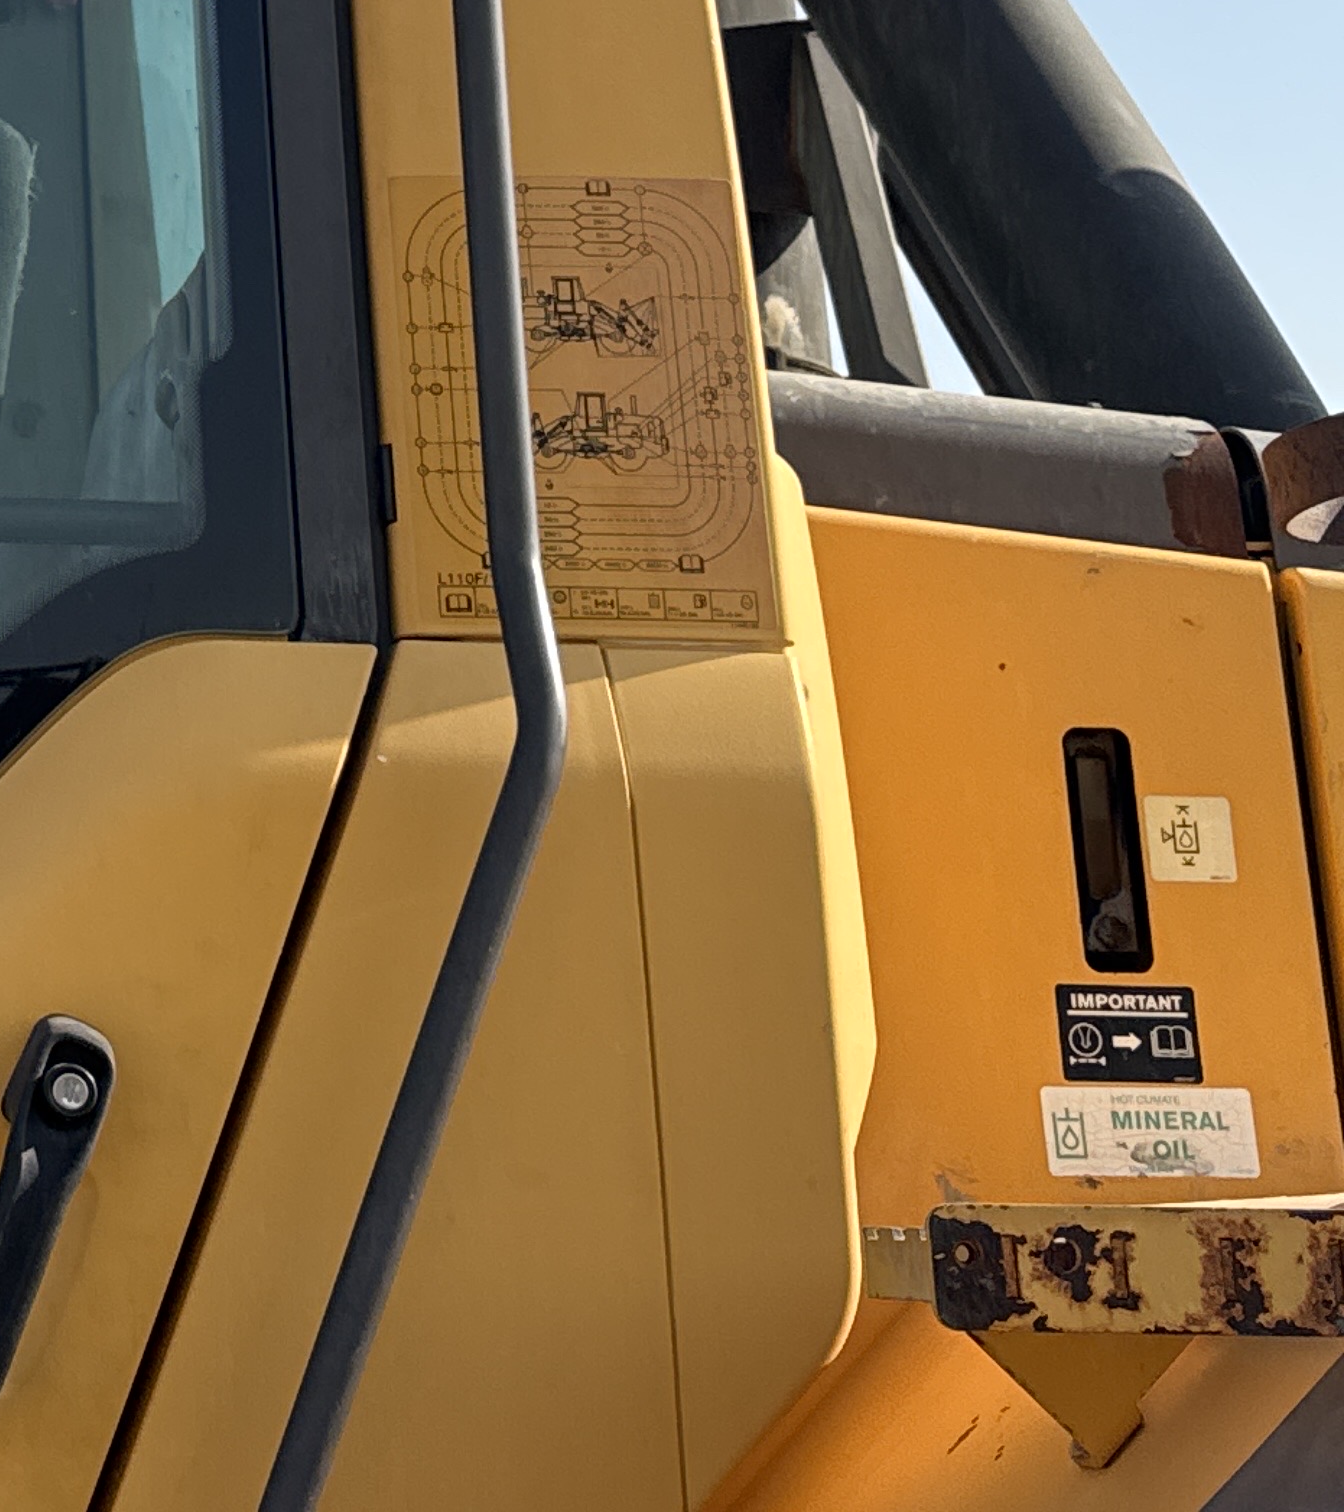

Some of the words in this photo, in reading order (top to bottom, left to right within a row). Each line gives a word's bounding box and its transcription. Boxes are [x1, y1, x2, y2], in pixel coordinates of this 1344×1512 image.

[1070, 993, 1183, 1011] IMPORTANT
[1110, 1110, 1231, 1131] MINERAL
[1152, 1139, 1196, 1160] OIL
